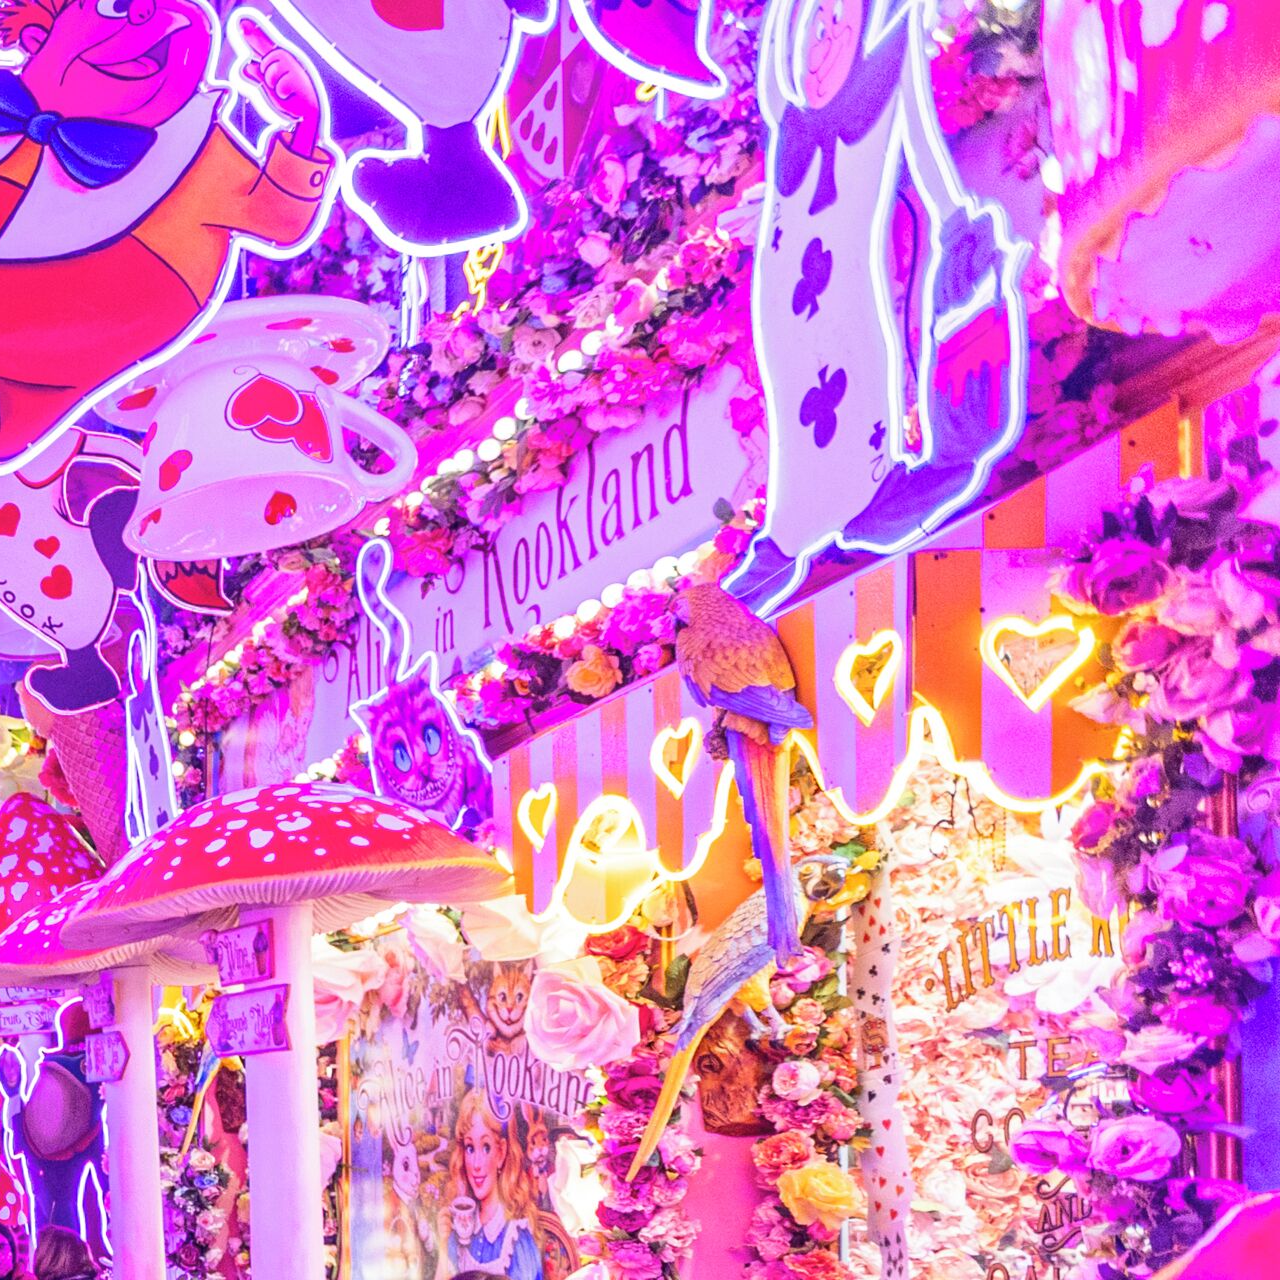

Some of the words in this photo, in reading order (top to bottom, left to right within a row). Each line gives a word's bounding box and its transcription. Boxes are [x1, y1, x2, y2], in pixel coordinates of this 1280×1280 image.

[435, 604, 456, 654] in
[937, 886, 1073, 1013] LITTLE
[434, 1058, 453, 1100] in
